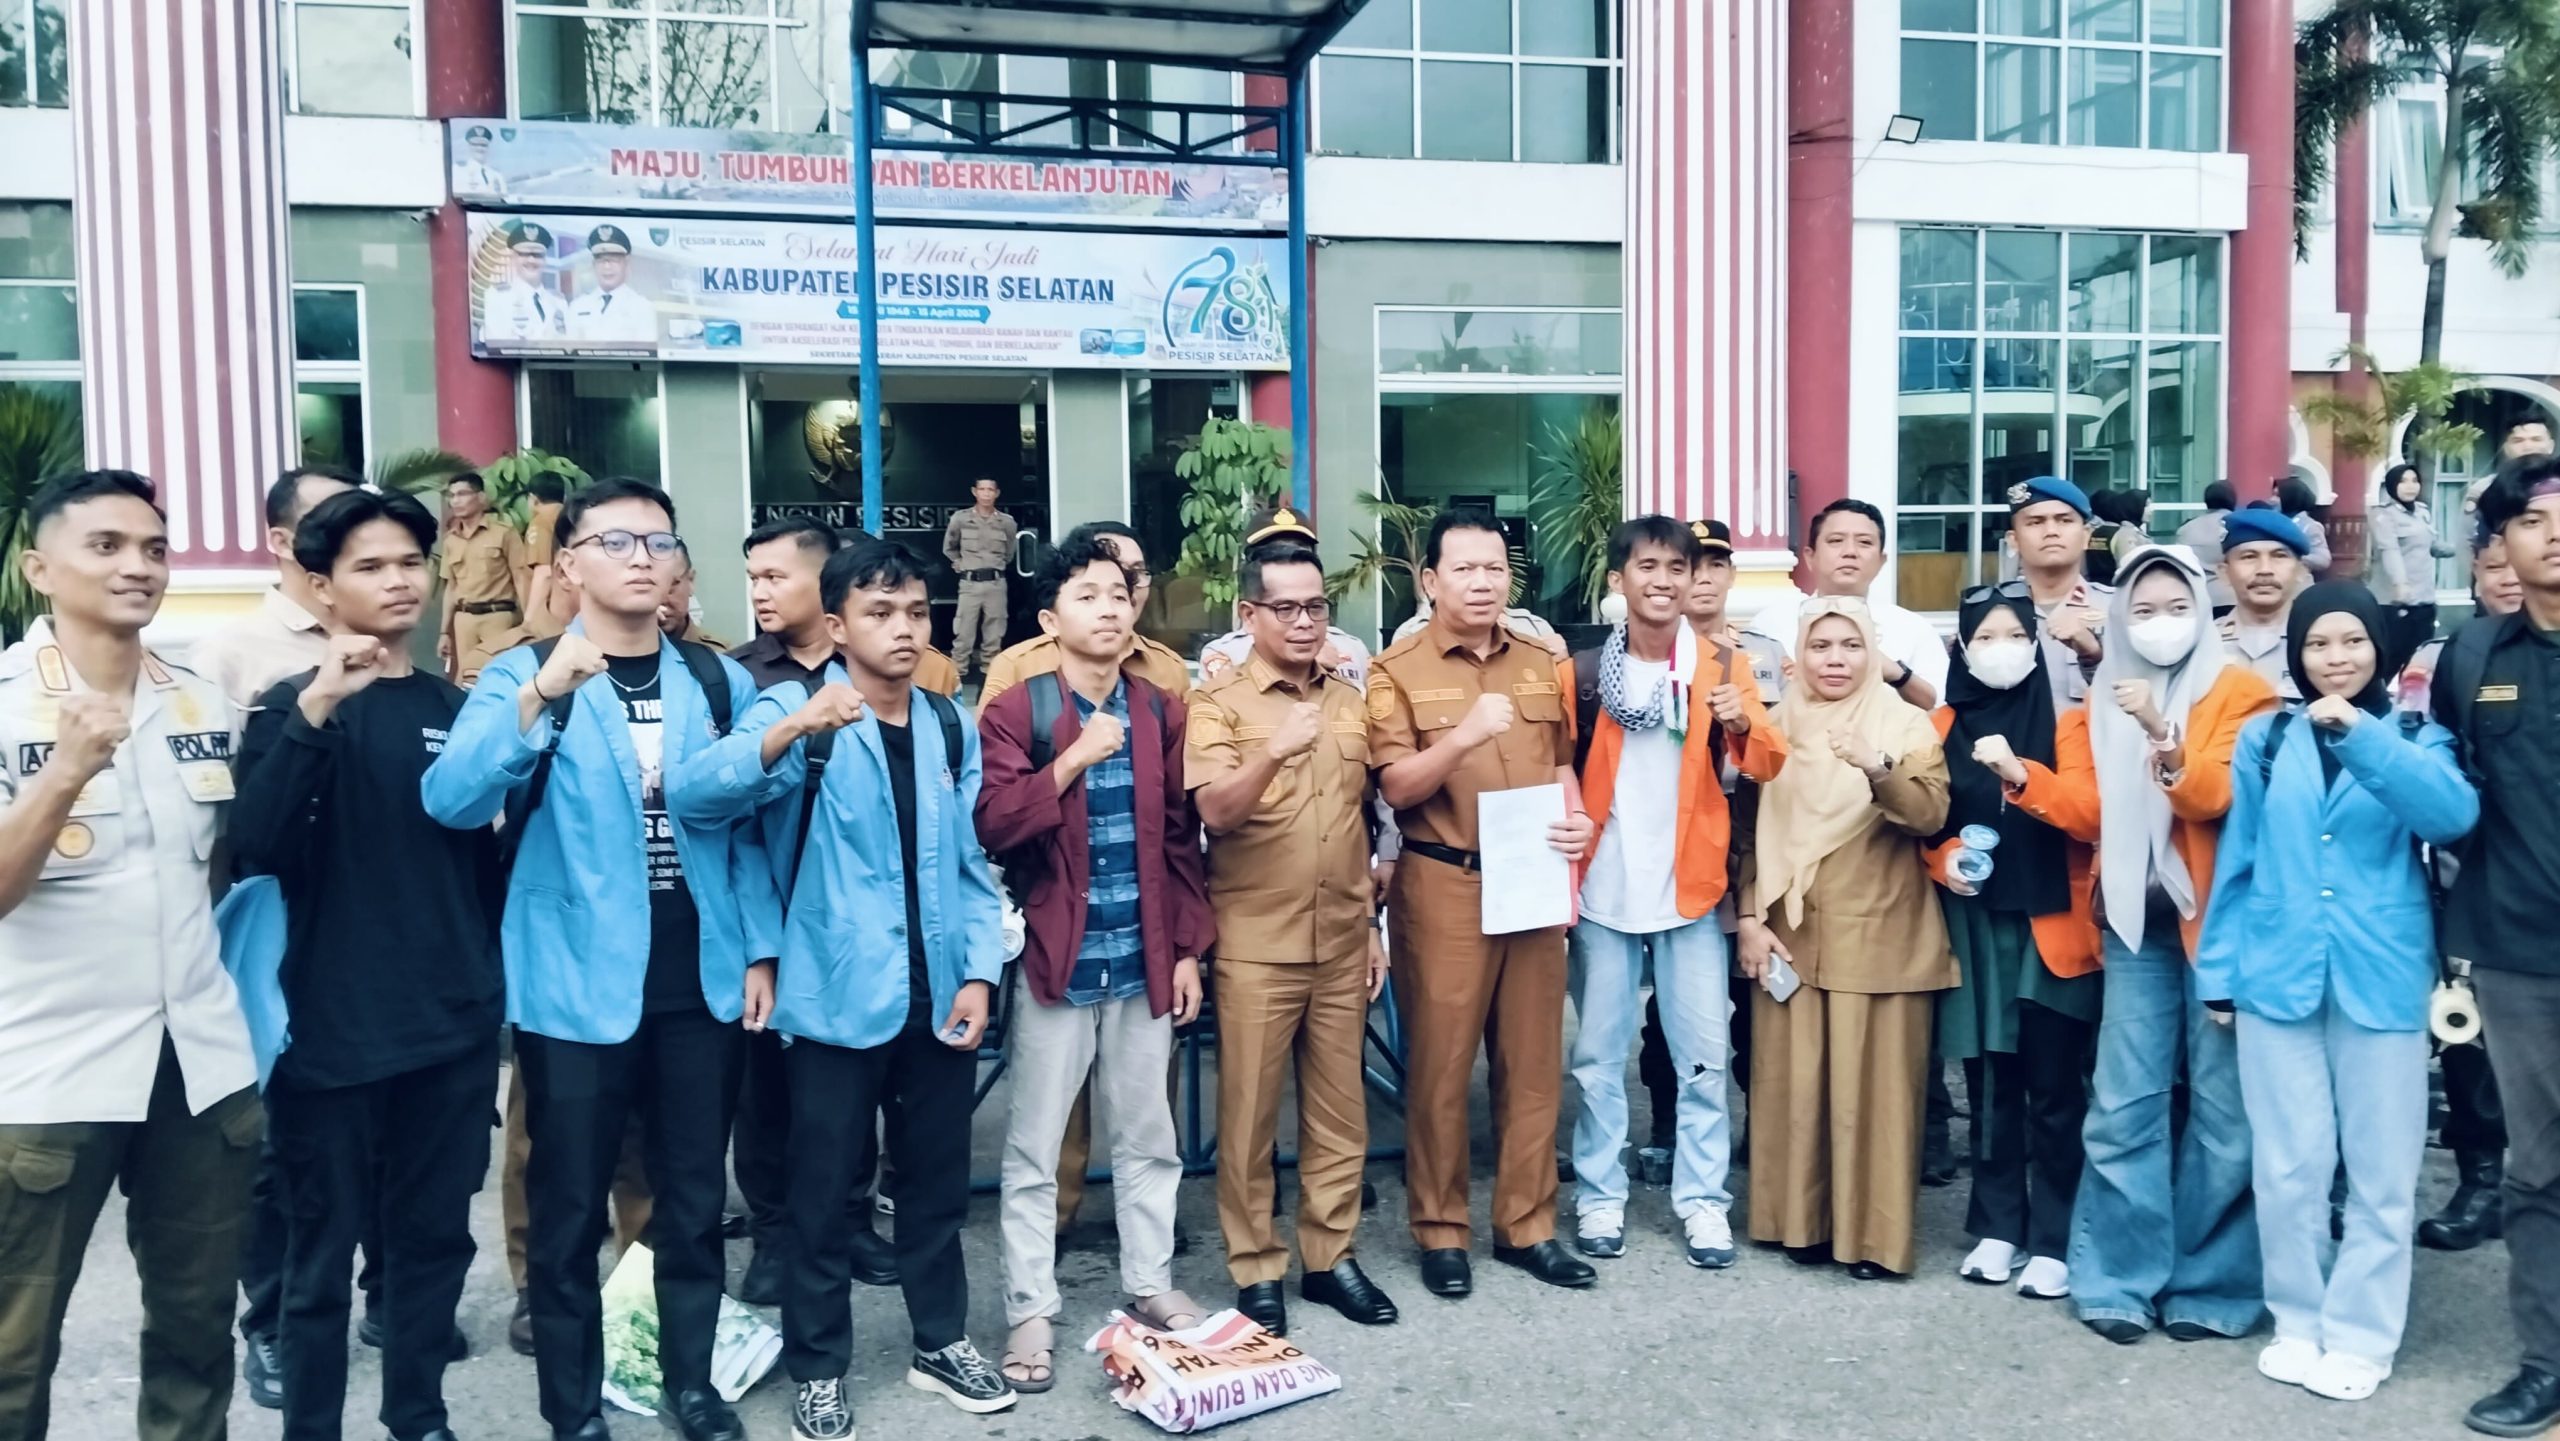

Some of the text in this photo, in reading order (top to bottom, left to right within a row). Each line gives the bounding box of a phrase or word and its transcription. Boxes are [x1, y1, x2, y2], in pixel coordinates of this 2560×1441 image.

[611, 148, 708, 181] MAJU,
[718, 153, 848, 184] TUMBUH
[931, 161, 1171, 197] BERKELANJUTAN
[720, 238, 765, 247] SELATAN
[882, 272, 989, 299] PESISIR
[1000, 276, 1114, 302] SELATAN
[810, 350, 861, 360] SEKRETARIA
[1168, 351, 1273, 361] PESISIR SELATAN
[1336, 669, 1359, 680] LRI
[1753, 669, 1772, 680] LRI
[1252, 1368, 1298, 1401] DAN
